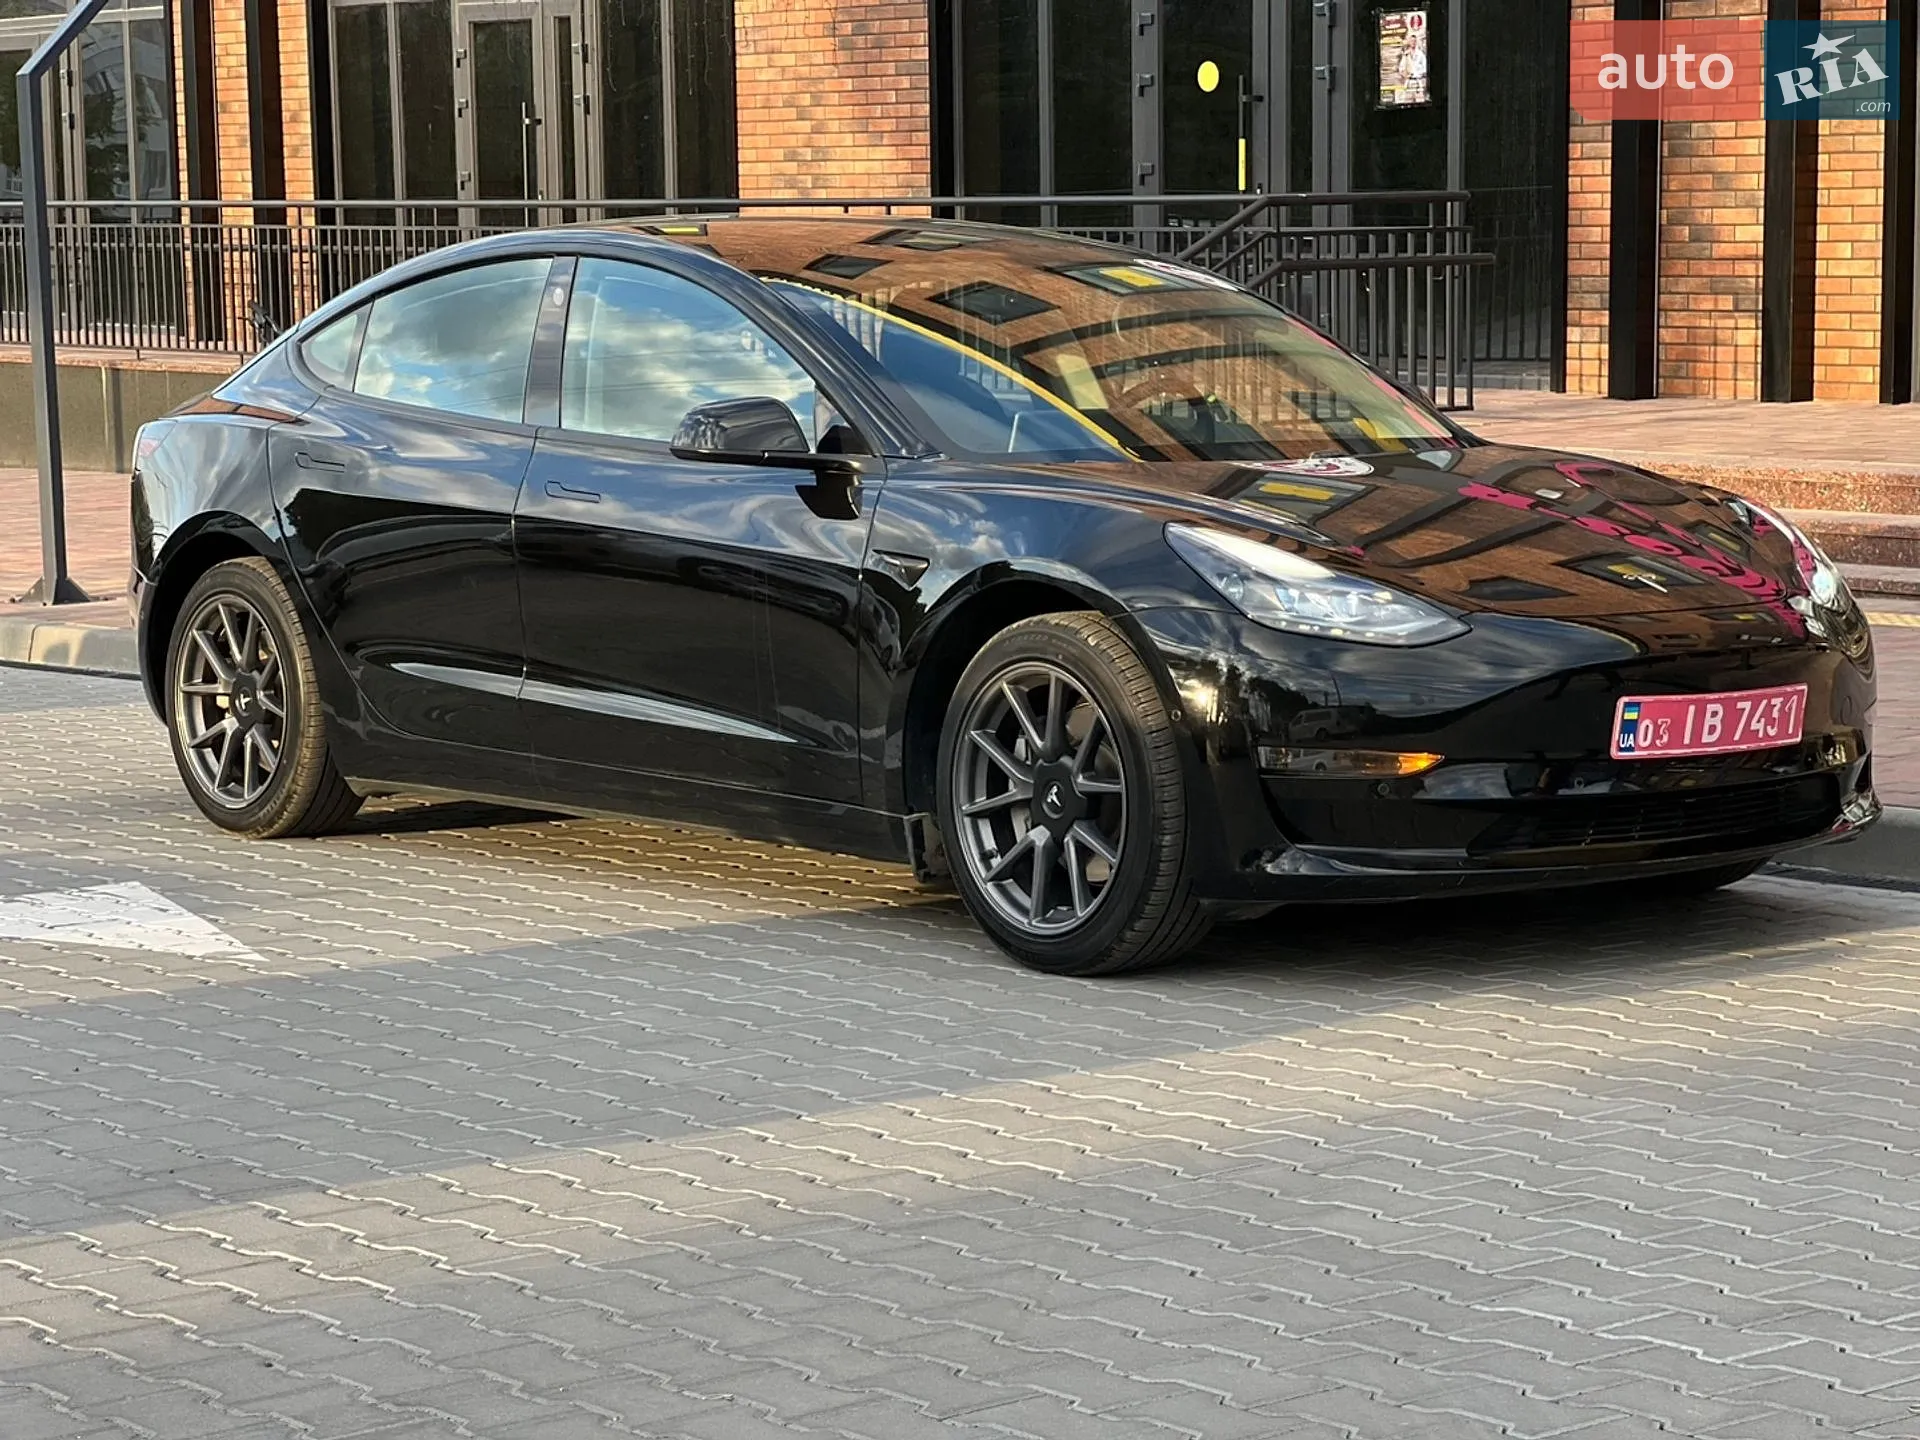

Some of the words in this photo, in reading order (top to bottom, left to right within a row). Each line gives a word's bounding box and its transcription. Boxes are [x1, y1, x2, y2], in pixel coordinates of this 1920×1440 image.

[1638, 719, 1671, 748] 03
[1683, 703, 1724, 745] IB
[1733, 695, 1798, 742] 7431
[1619, 733, 1635, 748] UA
